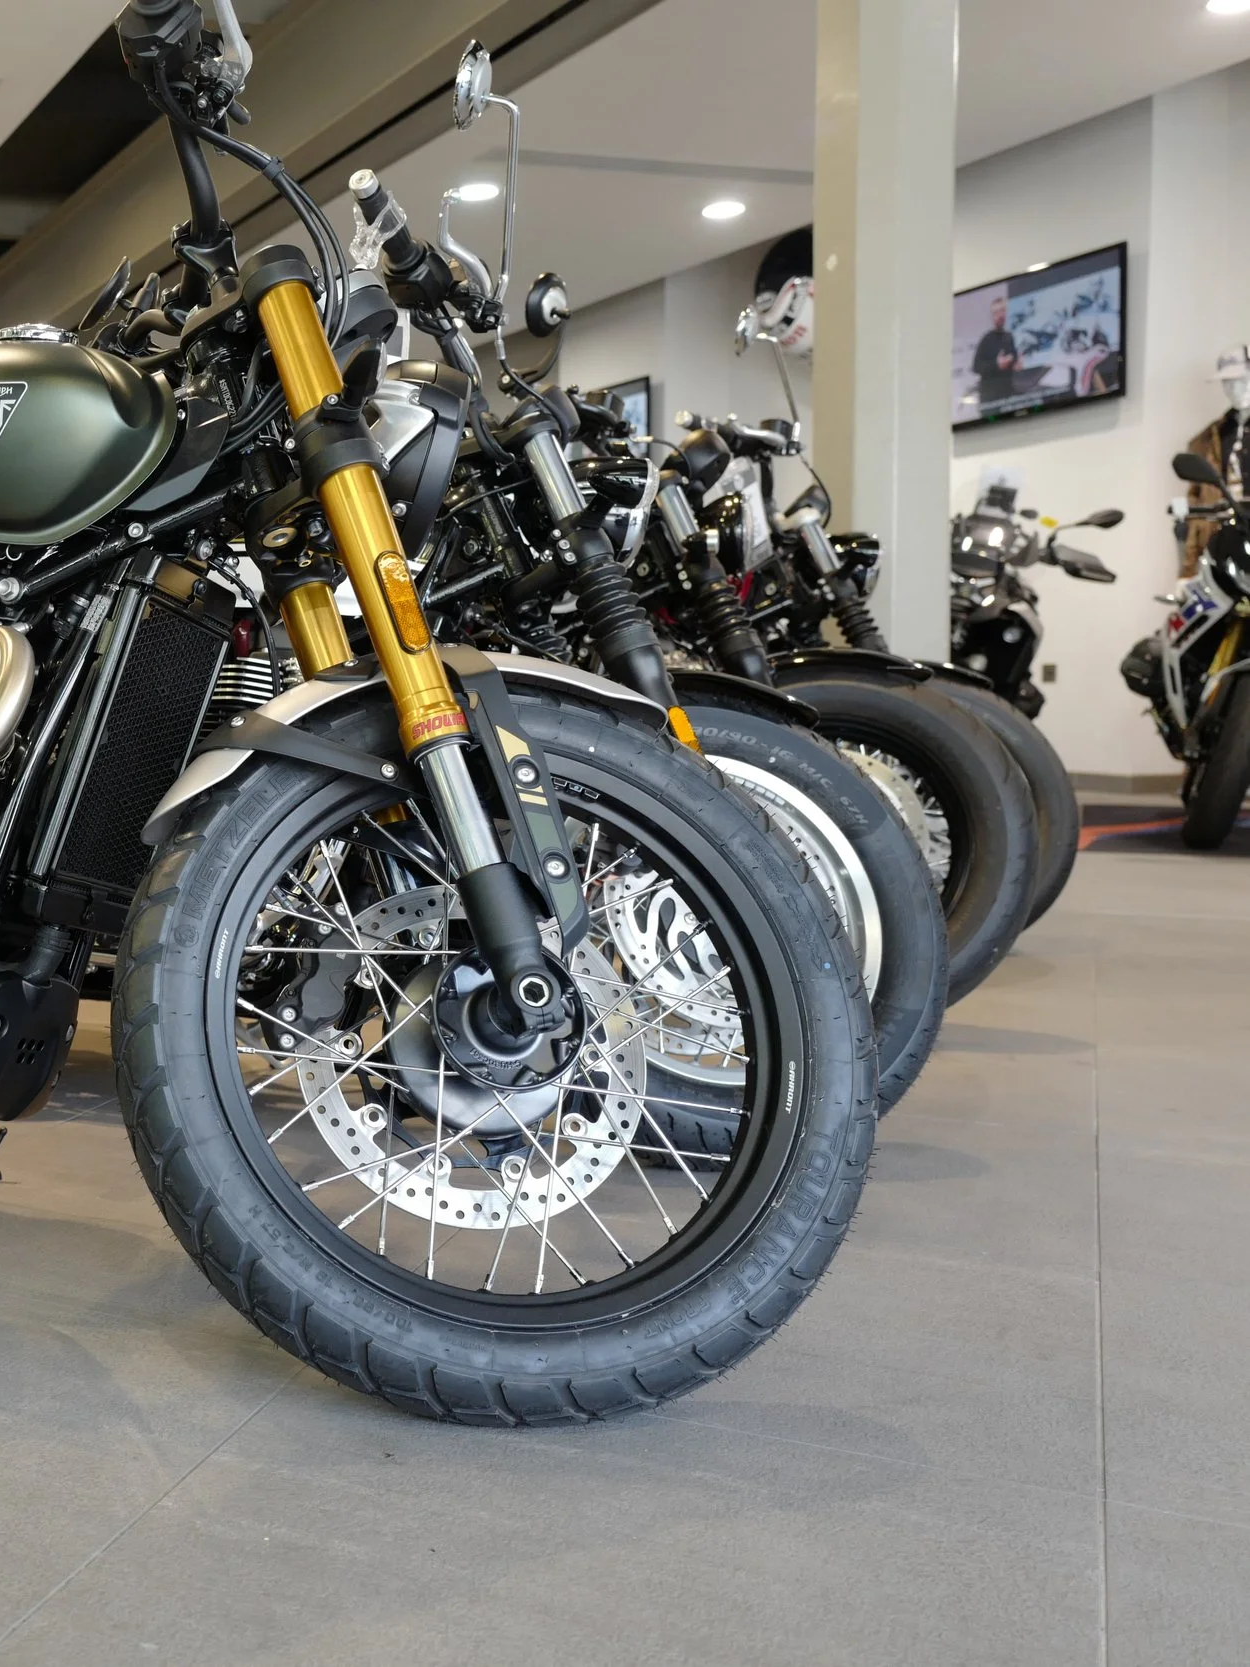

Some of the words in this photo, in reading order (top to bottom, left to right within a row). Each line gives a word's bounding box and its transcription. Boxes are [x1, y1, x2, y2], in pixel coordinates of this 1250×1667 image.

[182, 764, 303, 921] METZELE
[727, 1130, 840, 1305] TOURANCE
[645, 1295, 712, 1339] FRONT
